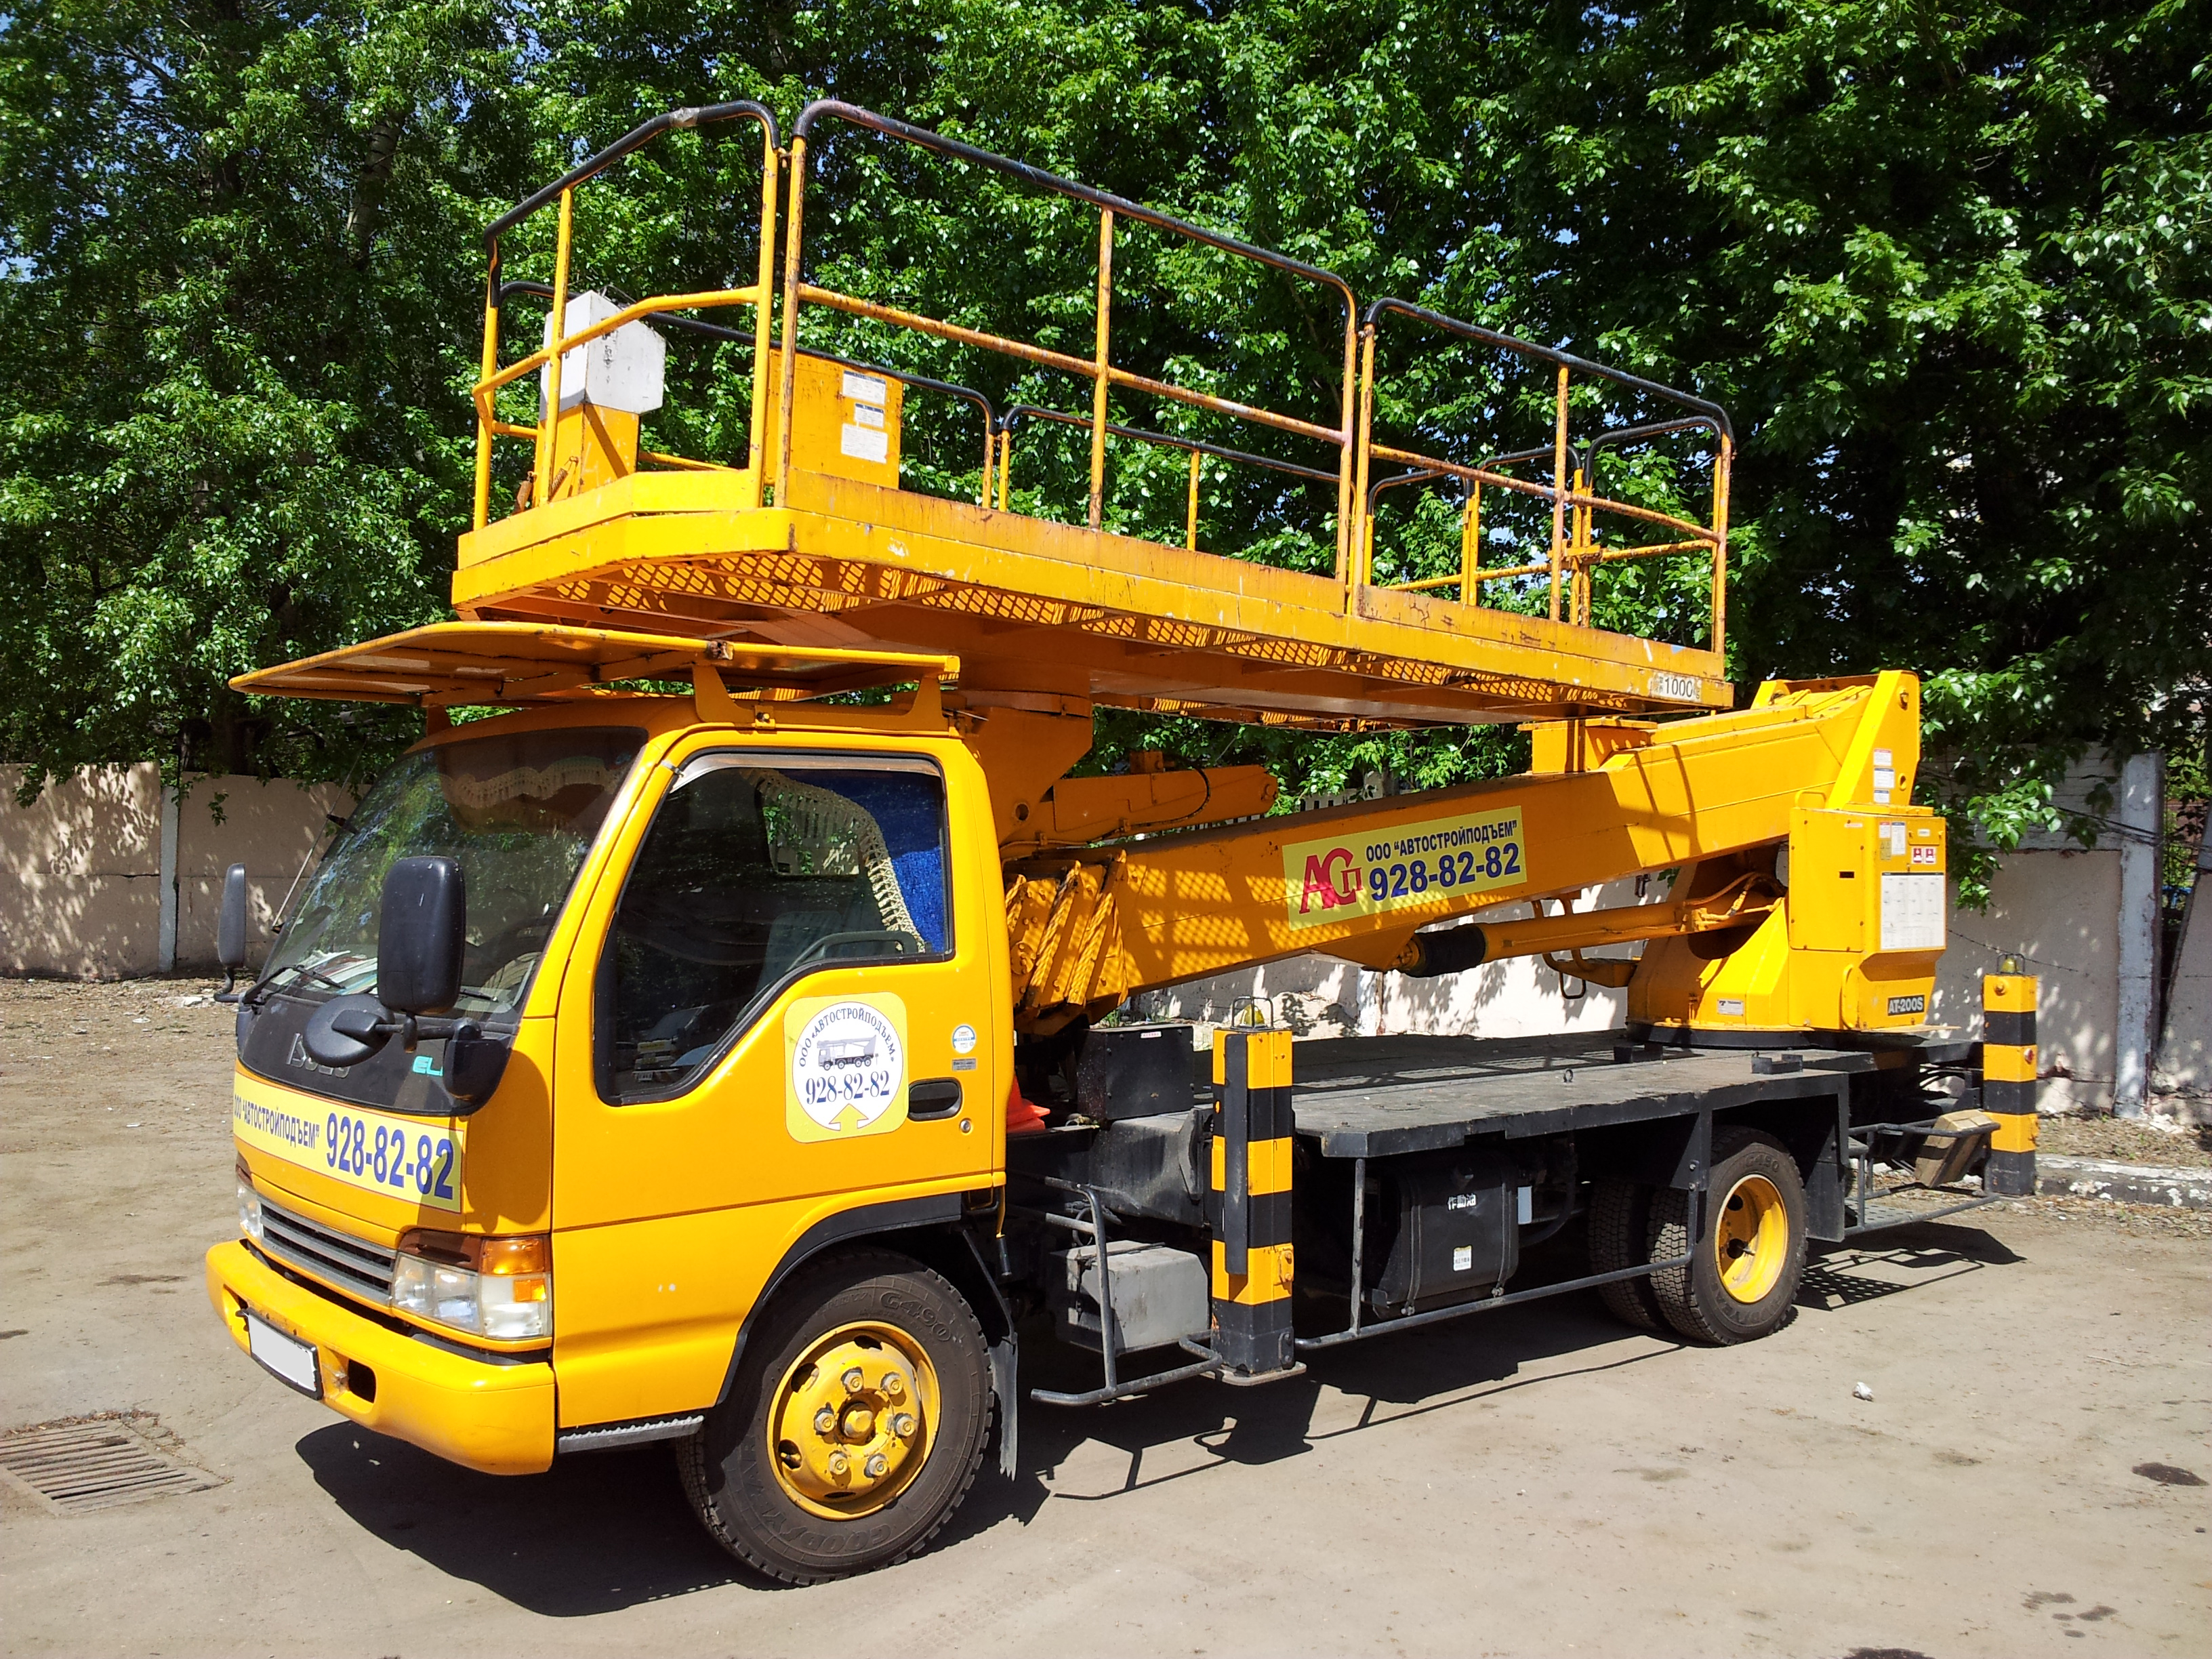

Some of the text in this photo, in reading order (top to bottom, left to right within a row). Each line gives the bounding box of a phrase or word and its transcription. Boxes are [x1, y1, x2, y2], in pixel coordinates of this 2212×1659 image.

[1366, 844, 1391, 863] ООО
[1369, 842, 1521, 901] 928-82-82
[1888, 997, 1923, 1014] AT-200S
[413, 1056, 444, 1077] EL
[799, 1038, 813, 1067] ООО
[806, 1070, 890, 1105] 928-82-82
[327, 1112, 454, 1200] 928-82-82
[1448, 1193, 1477, 1211] 作動油
[880, 1292, 951, 1342] G490
